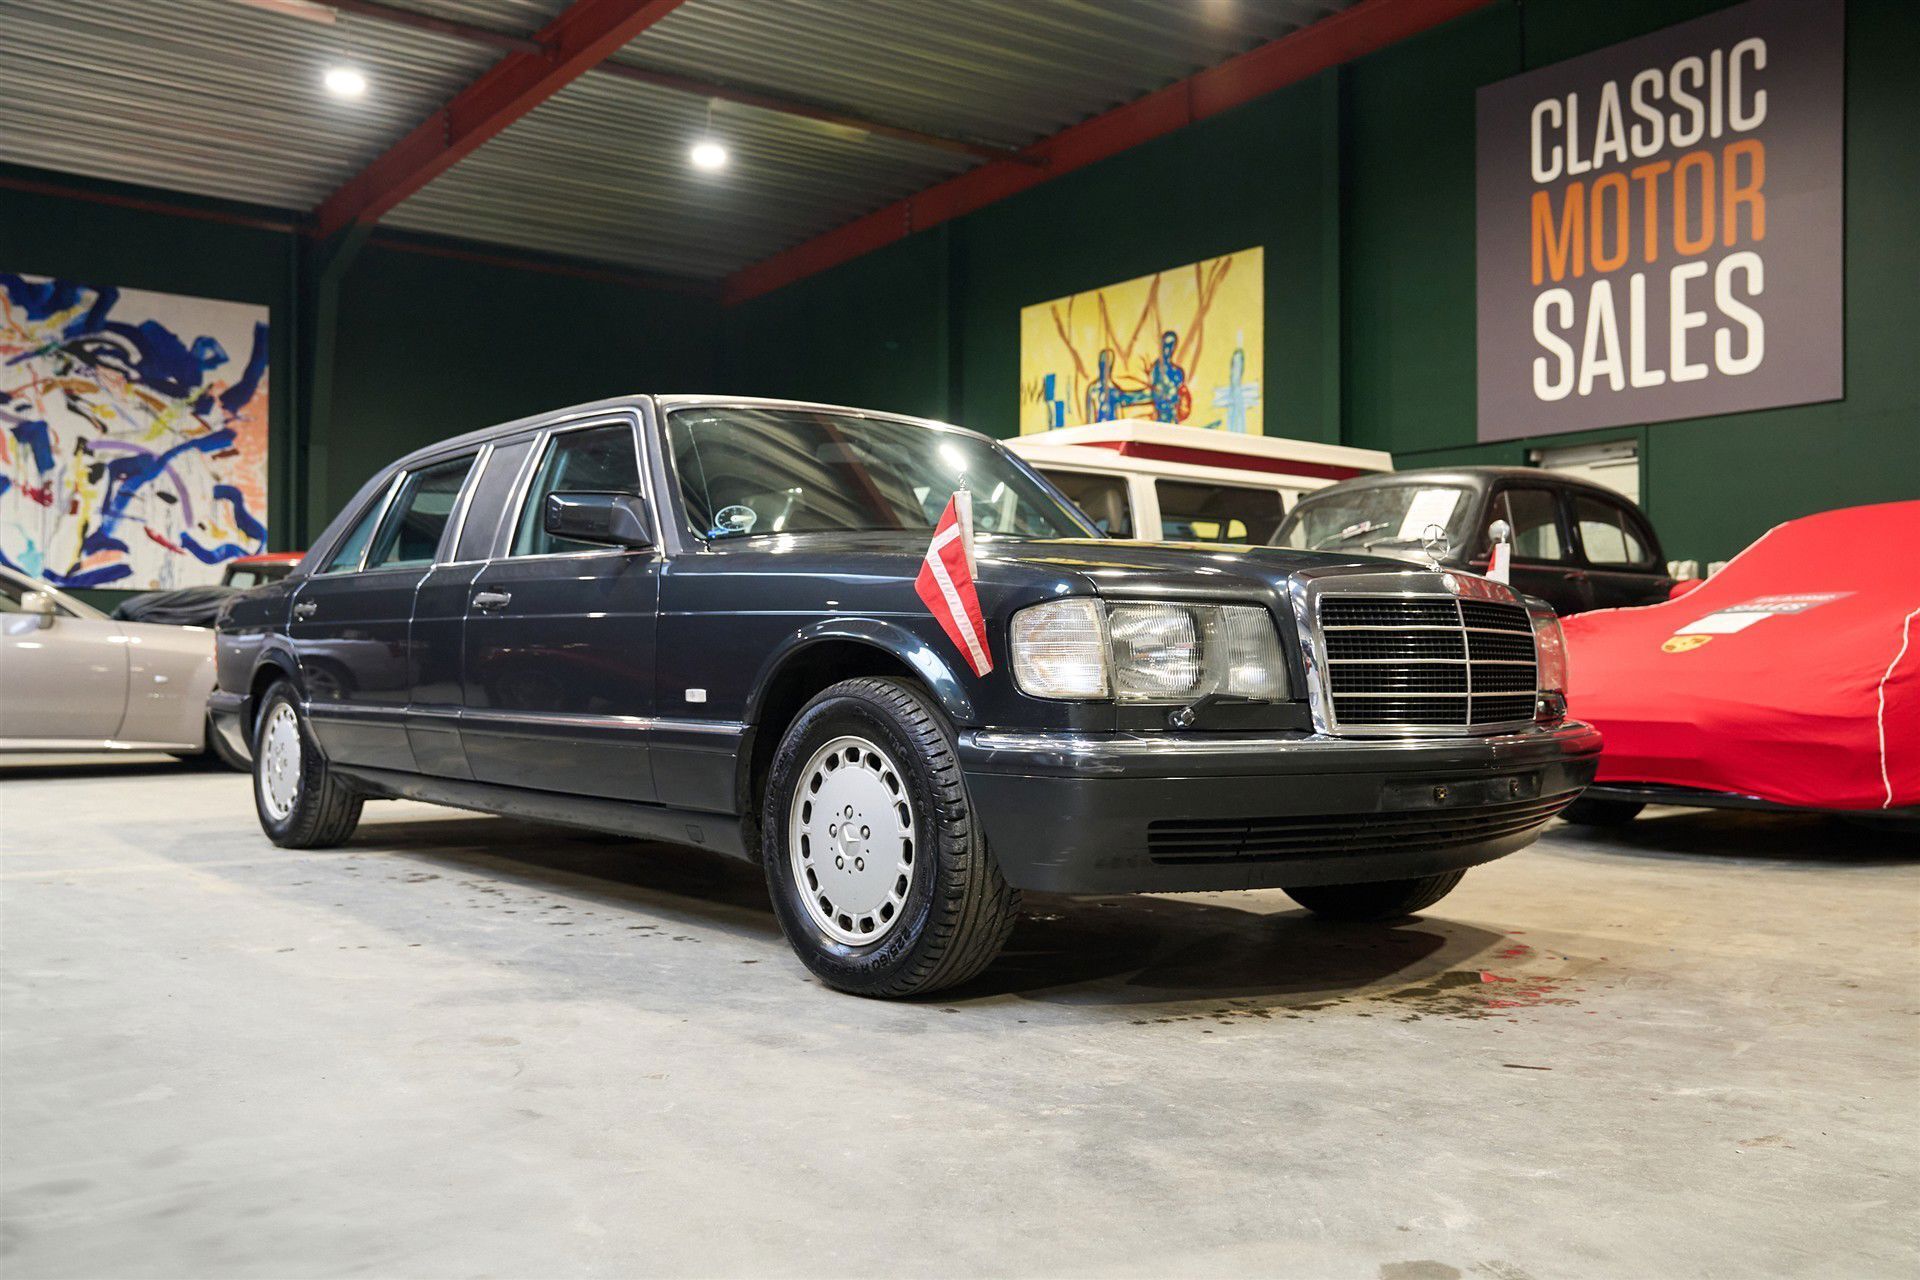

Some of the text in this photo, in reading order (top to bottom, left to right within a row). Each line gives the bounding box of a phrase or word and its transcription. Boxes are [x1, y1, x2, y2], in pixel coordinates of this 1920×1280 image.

[1531, 37, 1767, 183] CLASSIC
[1531, 139, 1766, 286] MOTOR
[1532, 251, 1765, 401] SALES
